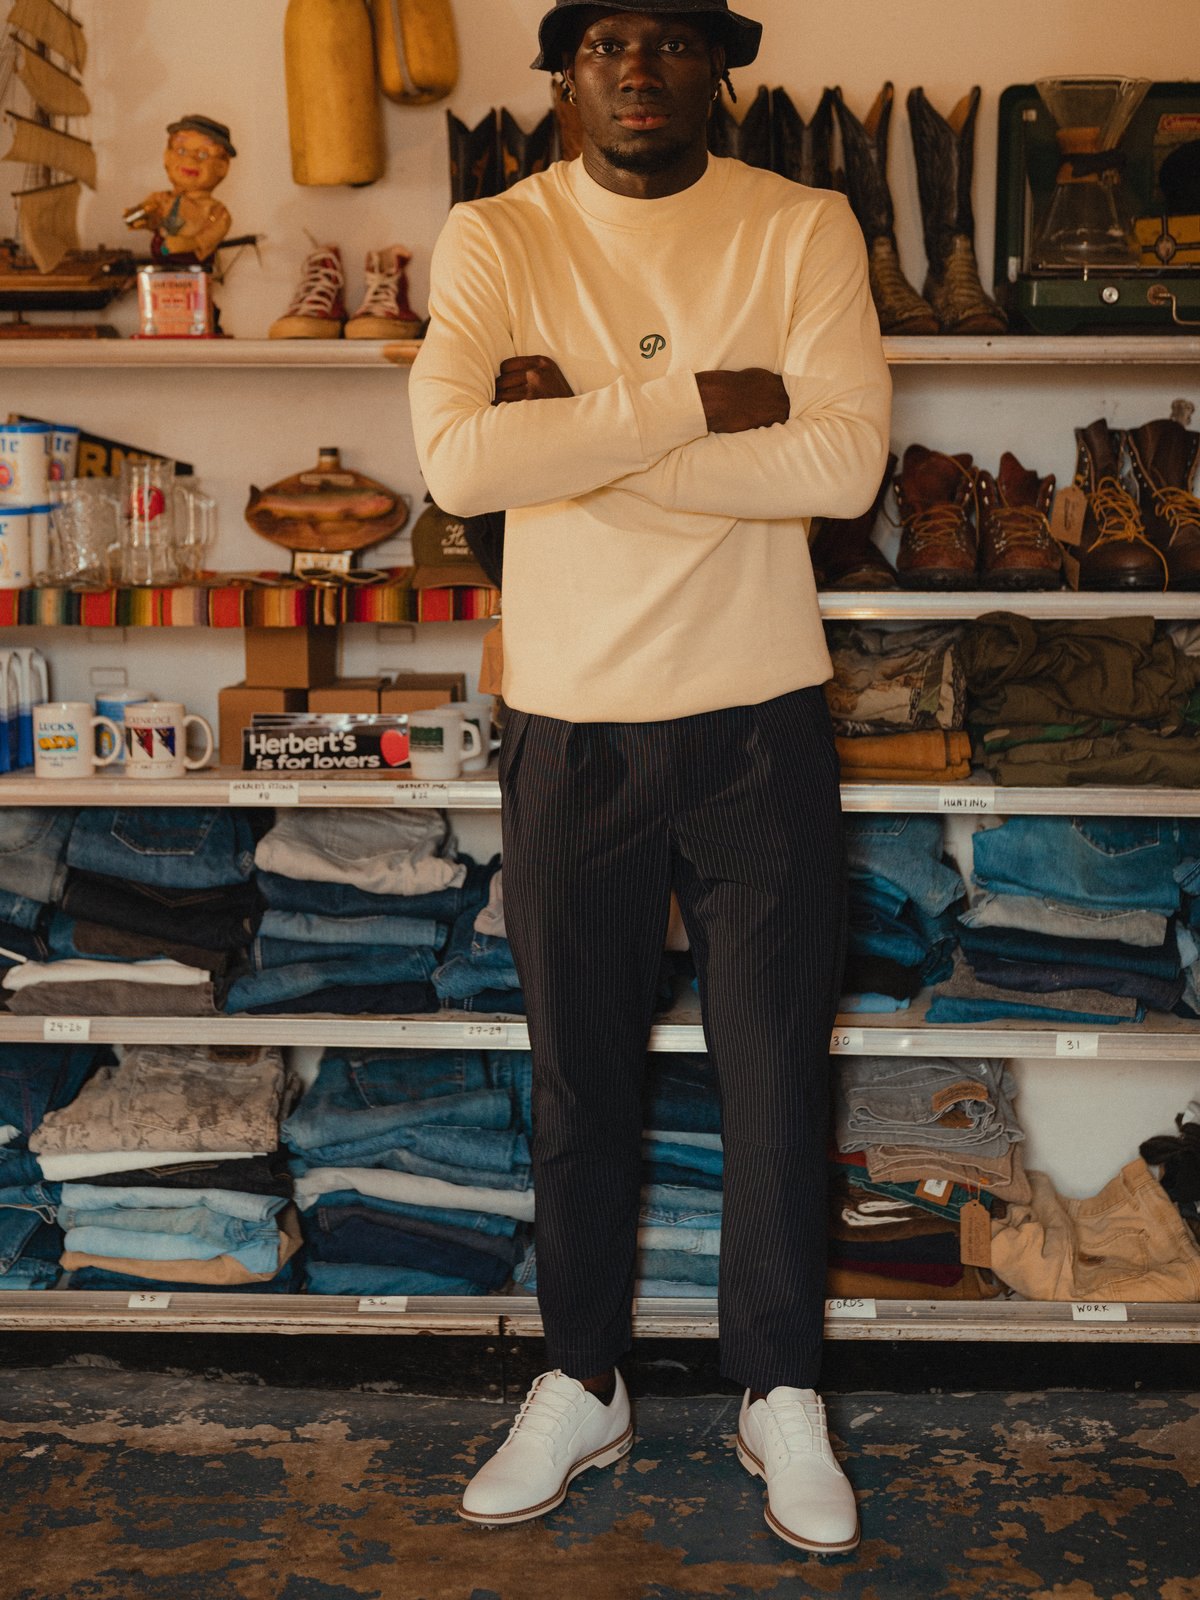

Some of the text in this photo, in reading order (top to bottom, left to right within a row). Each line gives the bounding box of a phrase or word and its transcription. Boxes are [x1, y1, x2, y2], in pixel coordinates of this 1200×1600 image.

[249, 731, 357, 756] Herbert's
[255, 752, 381, 771] is for lovers
[943, 798, 987, 808] HUNTING
[468, 1026, 502, 1036] 27-29
[833, 1035, 850, 1046] 30
[1066, 1040, 1080, 1050] 31
[828, 1299, 864, 1311] CORDS
[1076, 1304, 1109, 1313] WORK
